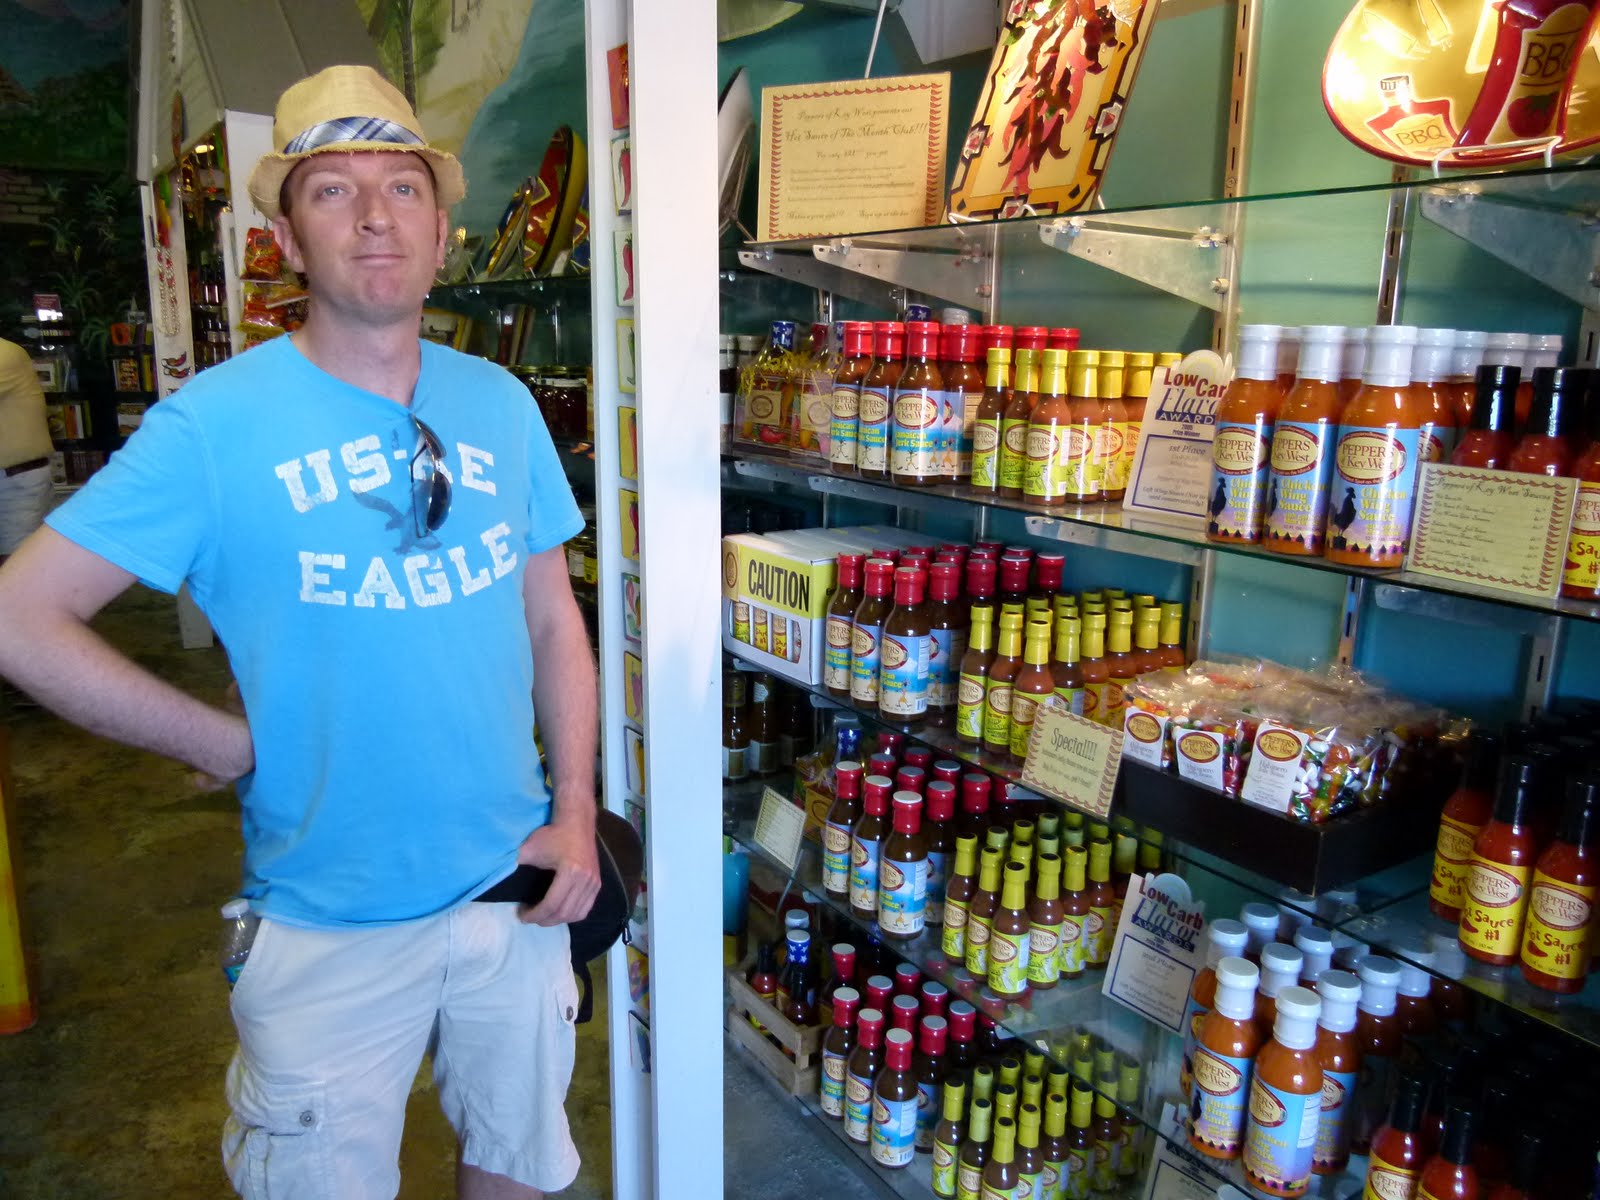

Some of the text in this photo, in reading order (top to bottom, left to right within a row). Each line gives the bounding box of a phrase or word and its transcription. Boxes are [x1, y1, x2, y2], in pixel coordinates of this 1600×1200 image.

[1396, 124, 1446, 146] BBQ
[1159, 413, 1214, 425] AWARD
[1236, 450, 1255, 462] Wes
[1287, 449, 1309, 462] West
[298, 522, 517, 609] EAGLE
[748, 559, 810, 613] CAUTION
[1475, 909, 1514, 928] Sauce
[1484, 929, 1500, 941] #1
[1543, 932, 1585, 952] Sauce
[1554, 953, 1570, 965] #1
